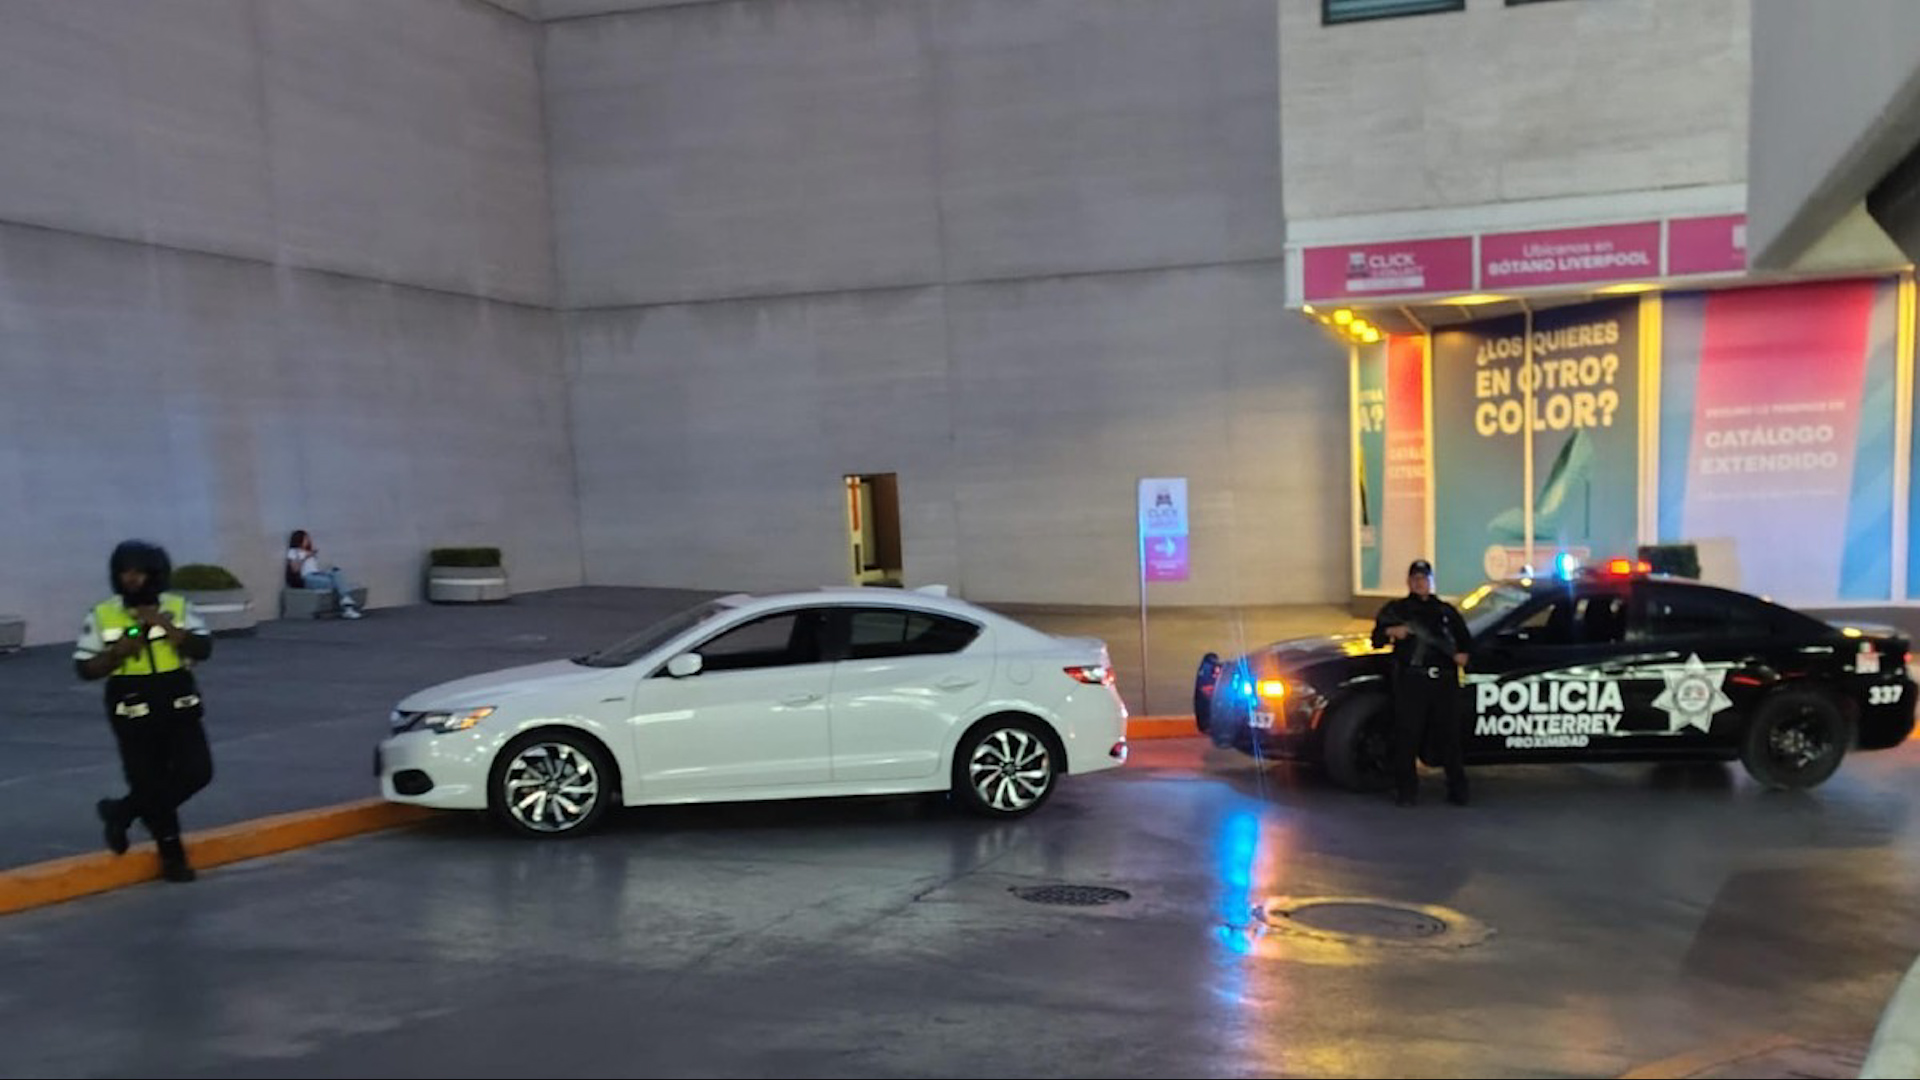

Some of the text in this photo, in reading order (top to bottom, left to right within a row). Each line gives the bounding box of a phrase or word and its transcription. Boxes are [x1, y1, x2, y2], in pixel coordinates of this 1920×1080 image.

[1368, 253, 1415, 269] CLICK
[1557, 250, 1649, 271] LIVERPOOL
[1476, 320, 1619, 366] ¿LOS QUIERES
[1476, 353, 1619, 398] EN OTRO?
[1475, 389, 1619, 437] COLOR?
[1705, 424, 1834, 449] CATÁLOGO
[1701, 451, 1838, 475] EXTENDIDO
[1868, 684, 1903, 705] 337
[1474, 713, 1622, 736] MONTERREY
[1505, 735, 1589, 748] PROXIMIDAD
